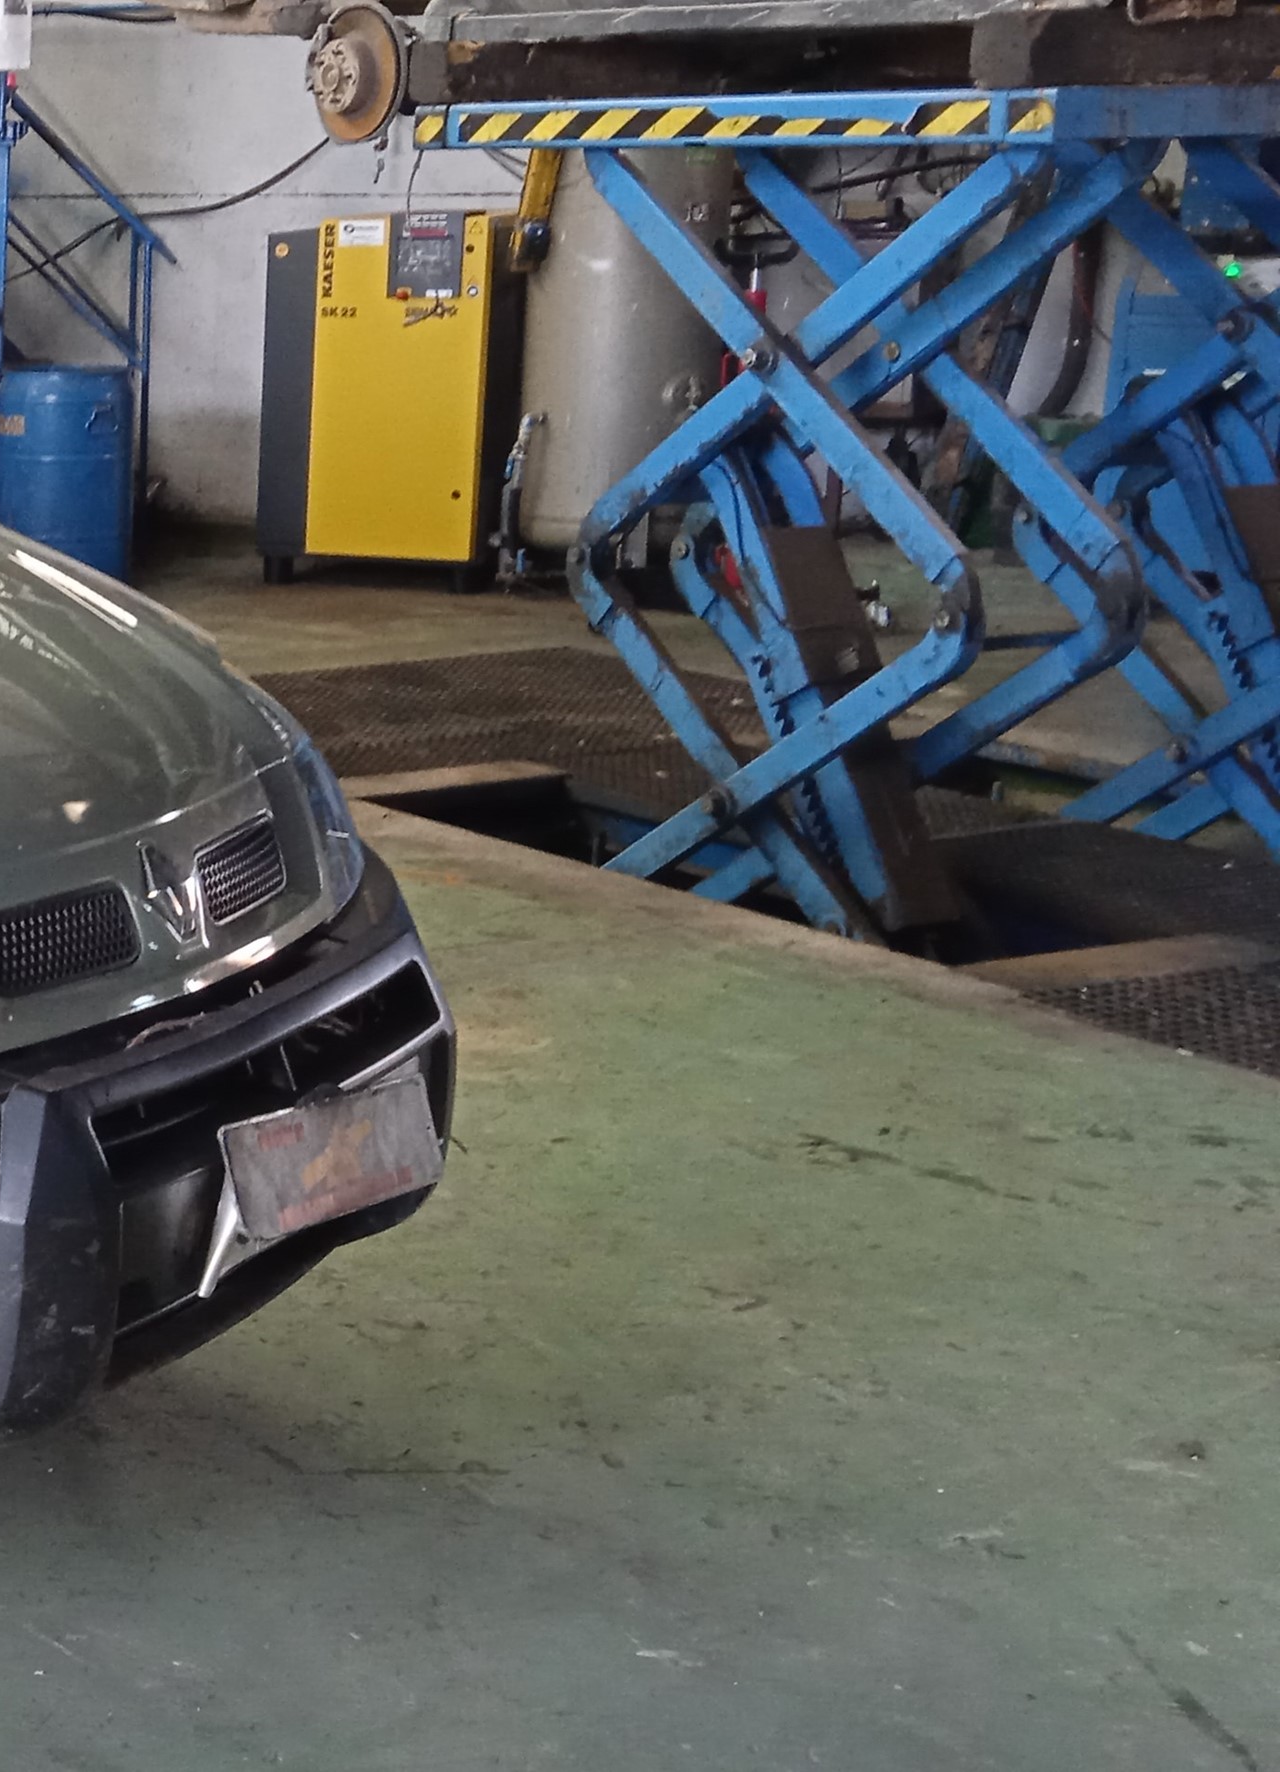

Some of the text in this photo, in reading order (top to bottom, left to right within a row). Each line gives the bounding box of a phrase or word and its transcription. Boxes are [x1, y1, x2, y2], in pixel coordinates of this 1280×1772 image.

[321, 224, 336, 298] KAESER
[321, 306, 358, 318] SK 22
